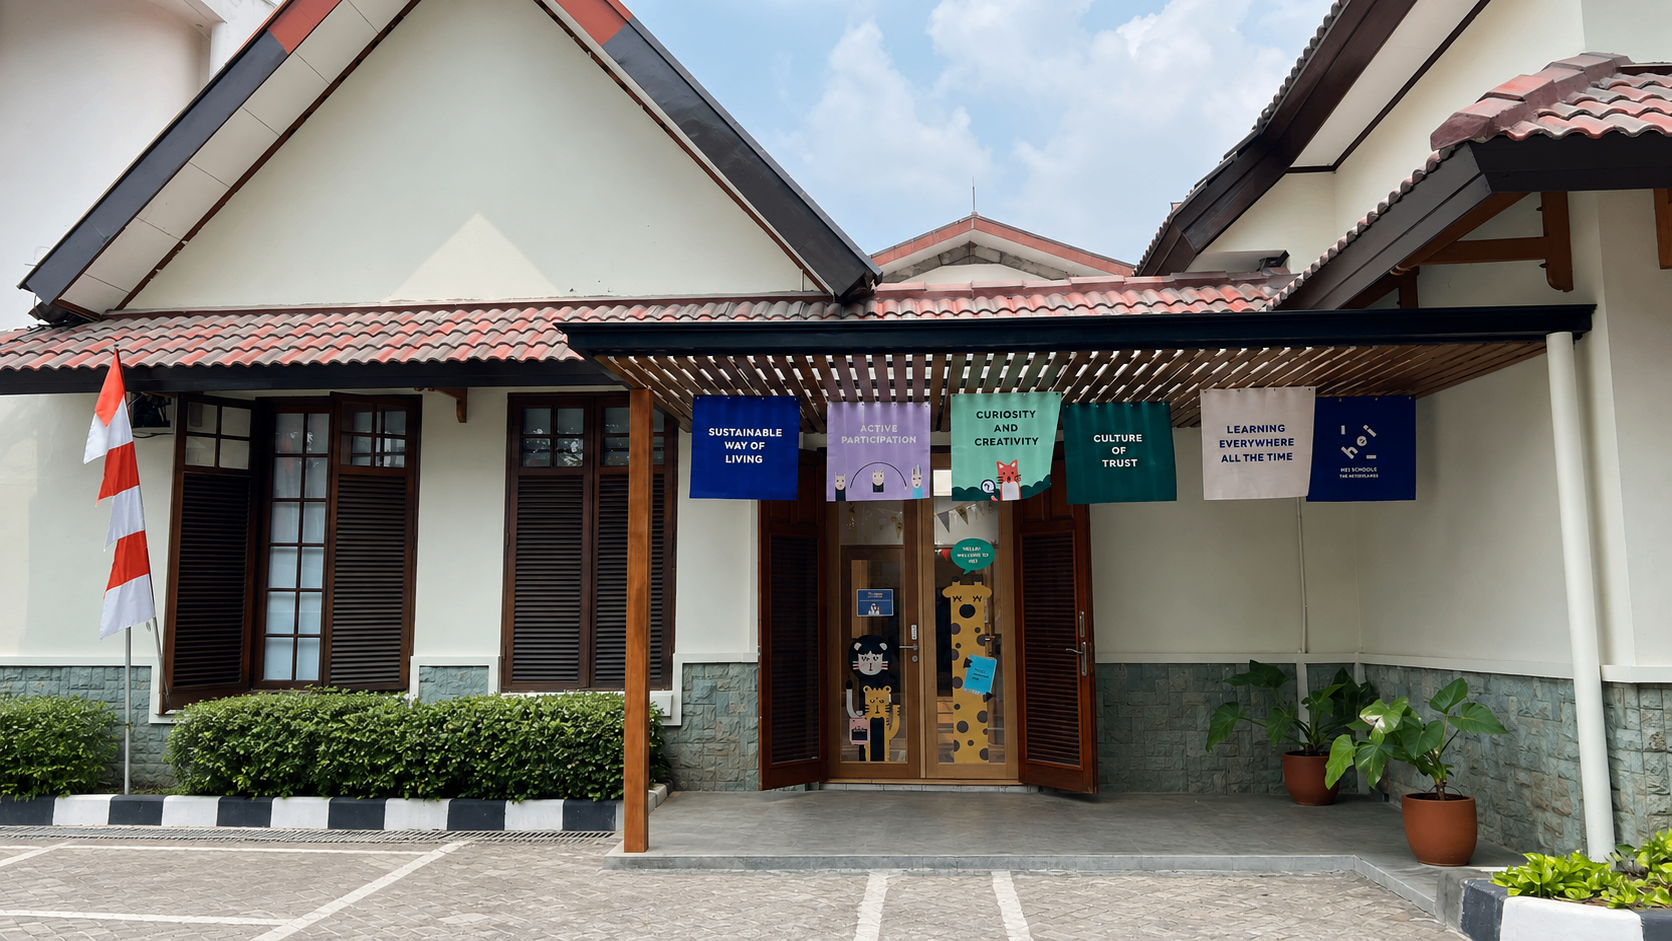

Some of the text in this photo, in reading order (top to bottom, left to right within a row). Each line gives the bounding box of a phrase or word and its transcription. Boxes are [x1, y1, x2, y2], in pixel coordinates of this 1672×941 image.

[976, 409, 1036, 419] CURIOSITY
[708, 427, 782, 437] SUSTAINABLE
[860, 424, 898, 433] ACTIVE
[994, 423, 1019, 433] AND
[1226, 424, 1286, 434] LEARNING
[841, 436, 917, 445] PARTICIPATION
[974, 437, 1039, 446] CREATIVITY
[1093, 434, 1143, 443] CULTURE
[1219, 438, 1295, 448] EVERYWHERE
[724, 441, 766, 450] WAY OF
[1111, 446, 1127, 455] OF
[725, 455, 763, 464] LIVING
[1221, 452, 1293, 463] ALL THE TIME
[1102, 458, 1138, 468] TRUST
